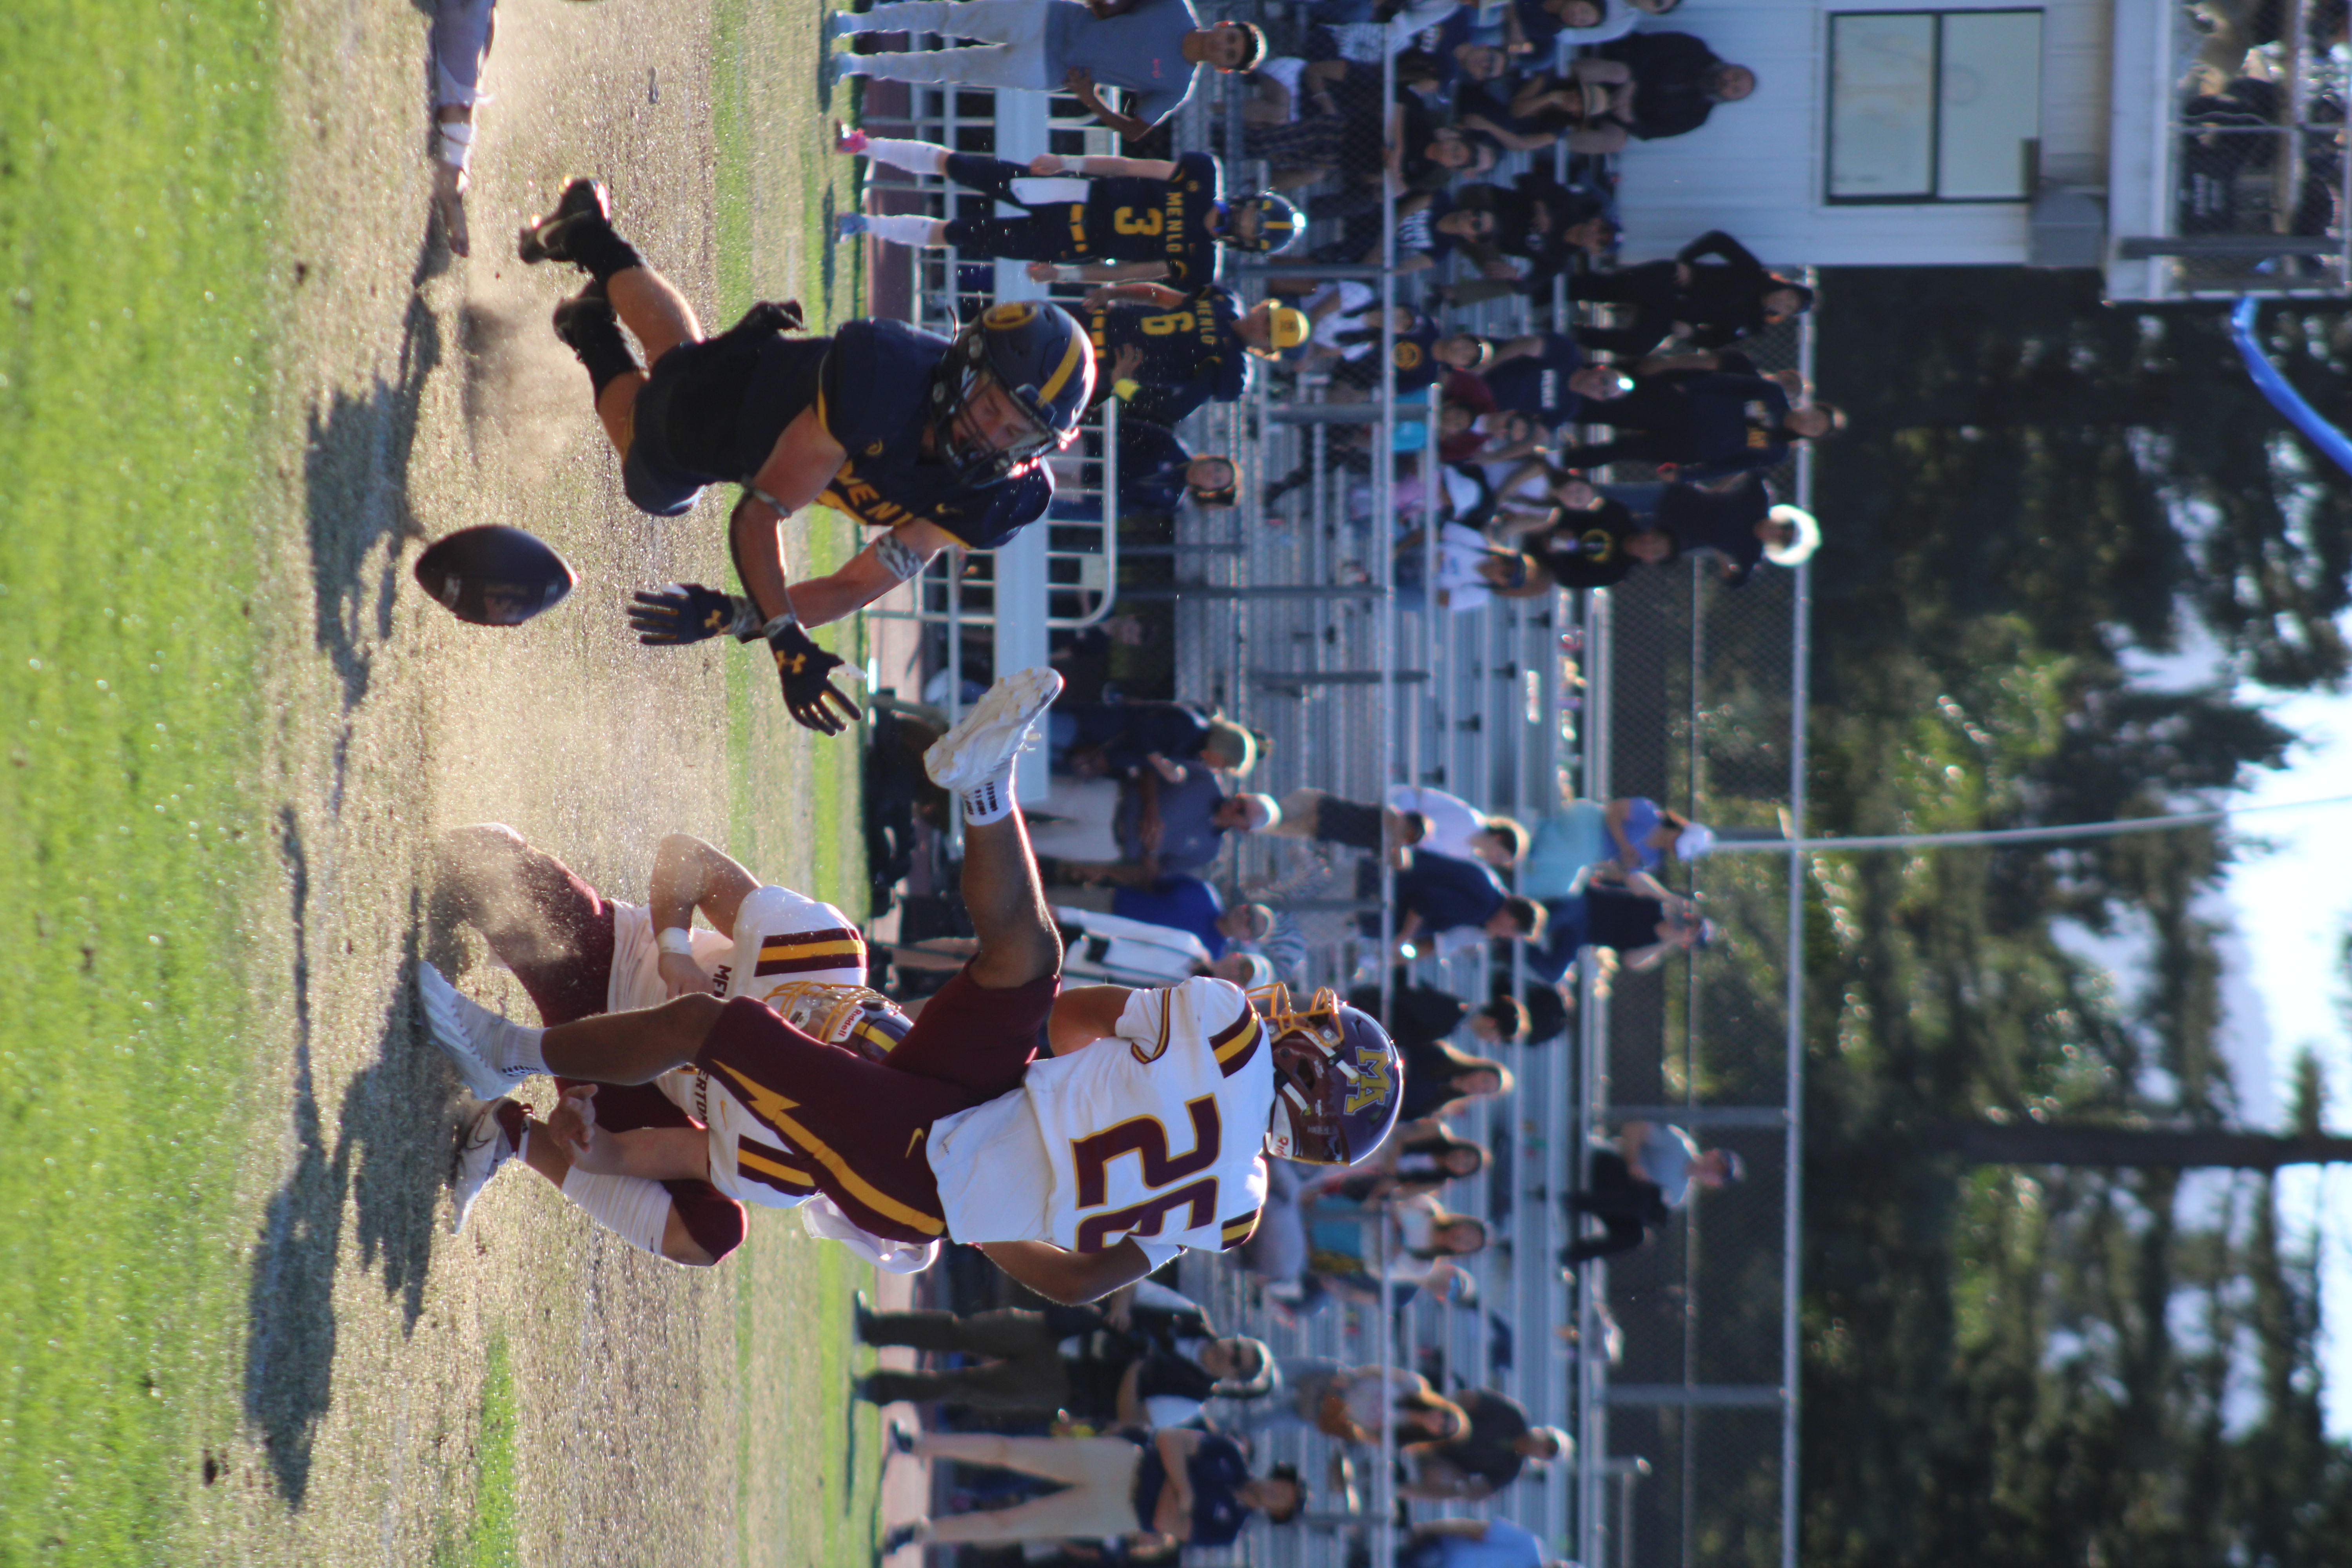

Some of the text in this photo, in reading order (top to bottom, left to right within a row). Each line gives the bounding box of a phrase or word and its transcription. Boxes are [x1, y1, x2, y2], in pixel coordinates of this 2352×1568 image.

[1114, 206, 1163, 236] 3
[1165, 192, 1184, 252] MENLO
[1140, 311, 1195, 336] 6
[1196, 299, 1217, 344] MENLO
[838, 1009, 862, 1037] Riddell
[1343, 1047, 1390, 1115] MA
[1069, 1092, 1222, 1253] 26
